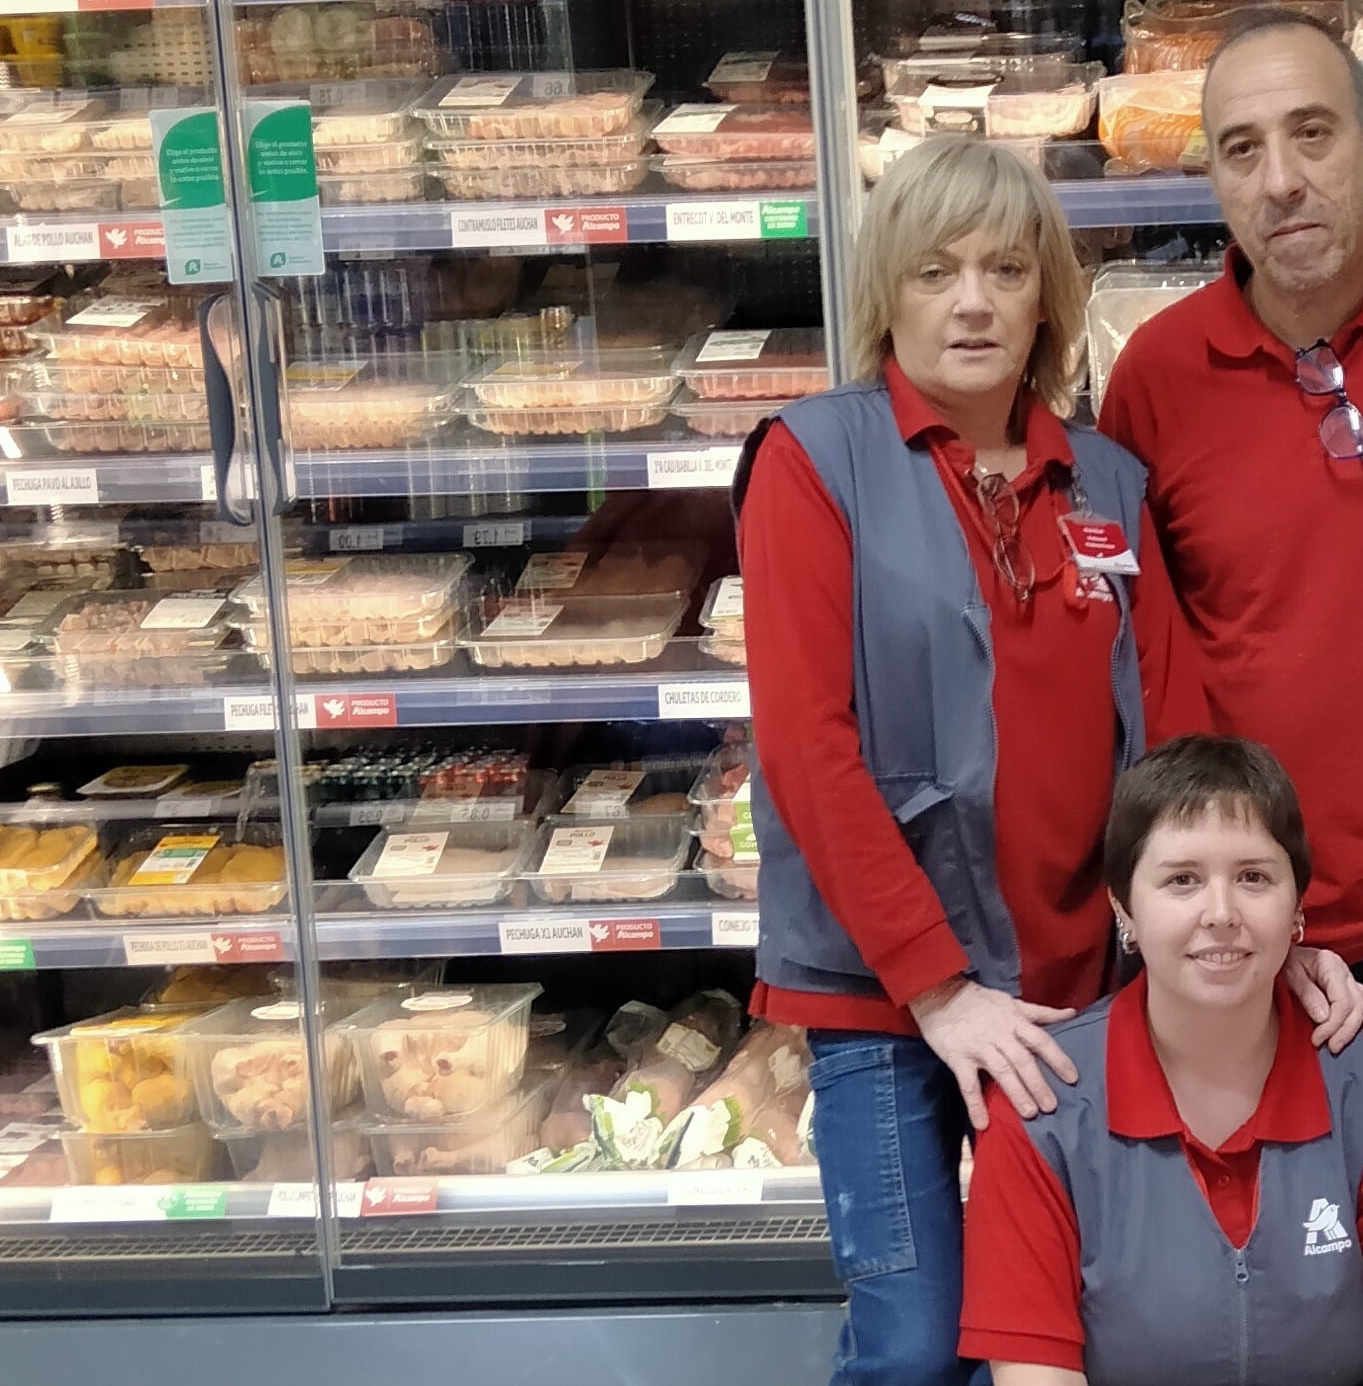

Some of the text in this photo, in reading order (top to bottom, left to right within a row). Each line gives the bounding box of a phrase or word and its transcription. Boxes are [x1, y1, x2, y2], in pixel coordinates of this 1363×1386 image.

[581, 213, 619, 221] PRODUCTO
[673, 212, 707, 225] ENTRECOT
[717, 211, 729, 224] DEL
[731, 210, 754, 224] MONTE
[517, 217, 538, 230] AUCHAN
[582, 221, 620, 231] Alcampo
[42, 232, 64, 246] POLLO
[65, 231, 93, 245] AUCHAN
[352, 698, 389, 707] PRODUCTO
[665, 690, 742, 704] CHULETAS DE CORDERO
[230, 704, 260, 717] PECHUGA
[353, 707, 390, 716] Alcampo
[616, 922, 653, 930] PRODUCTO
[719, 919, 750, 932] CONEJO
[506, 926, 540, 940] PECHUGA
[552, 925, 583, 939] AUCHAN
[617, 930, 654, 939] Alcampo
[238, 936, 275, 944] PRODUCTO
[239, 943, 277, 952] Alcampo
[1304, 1238, 1351, 1256] Alcampo
